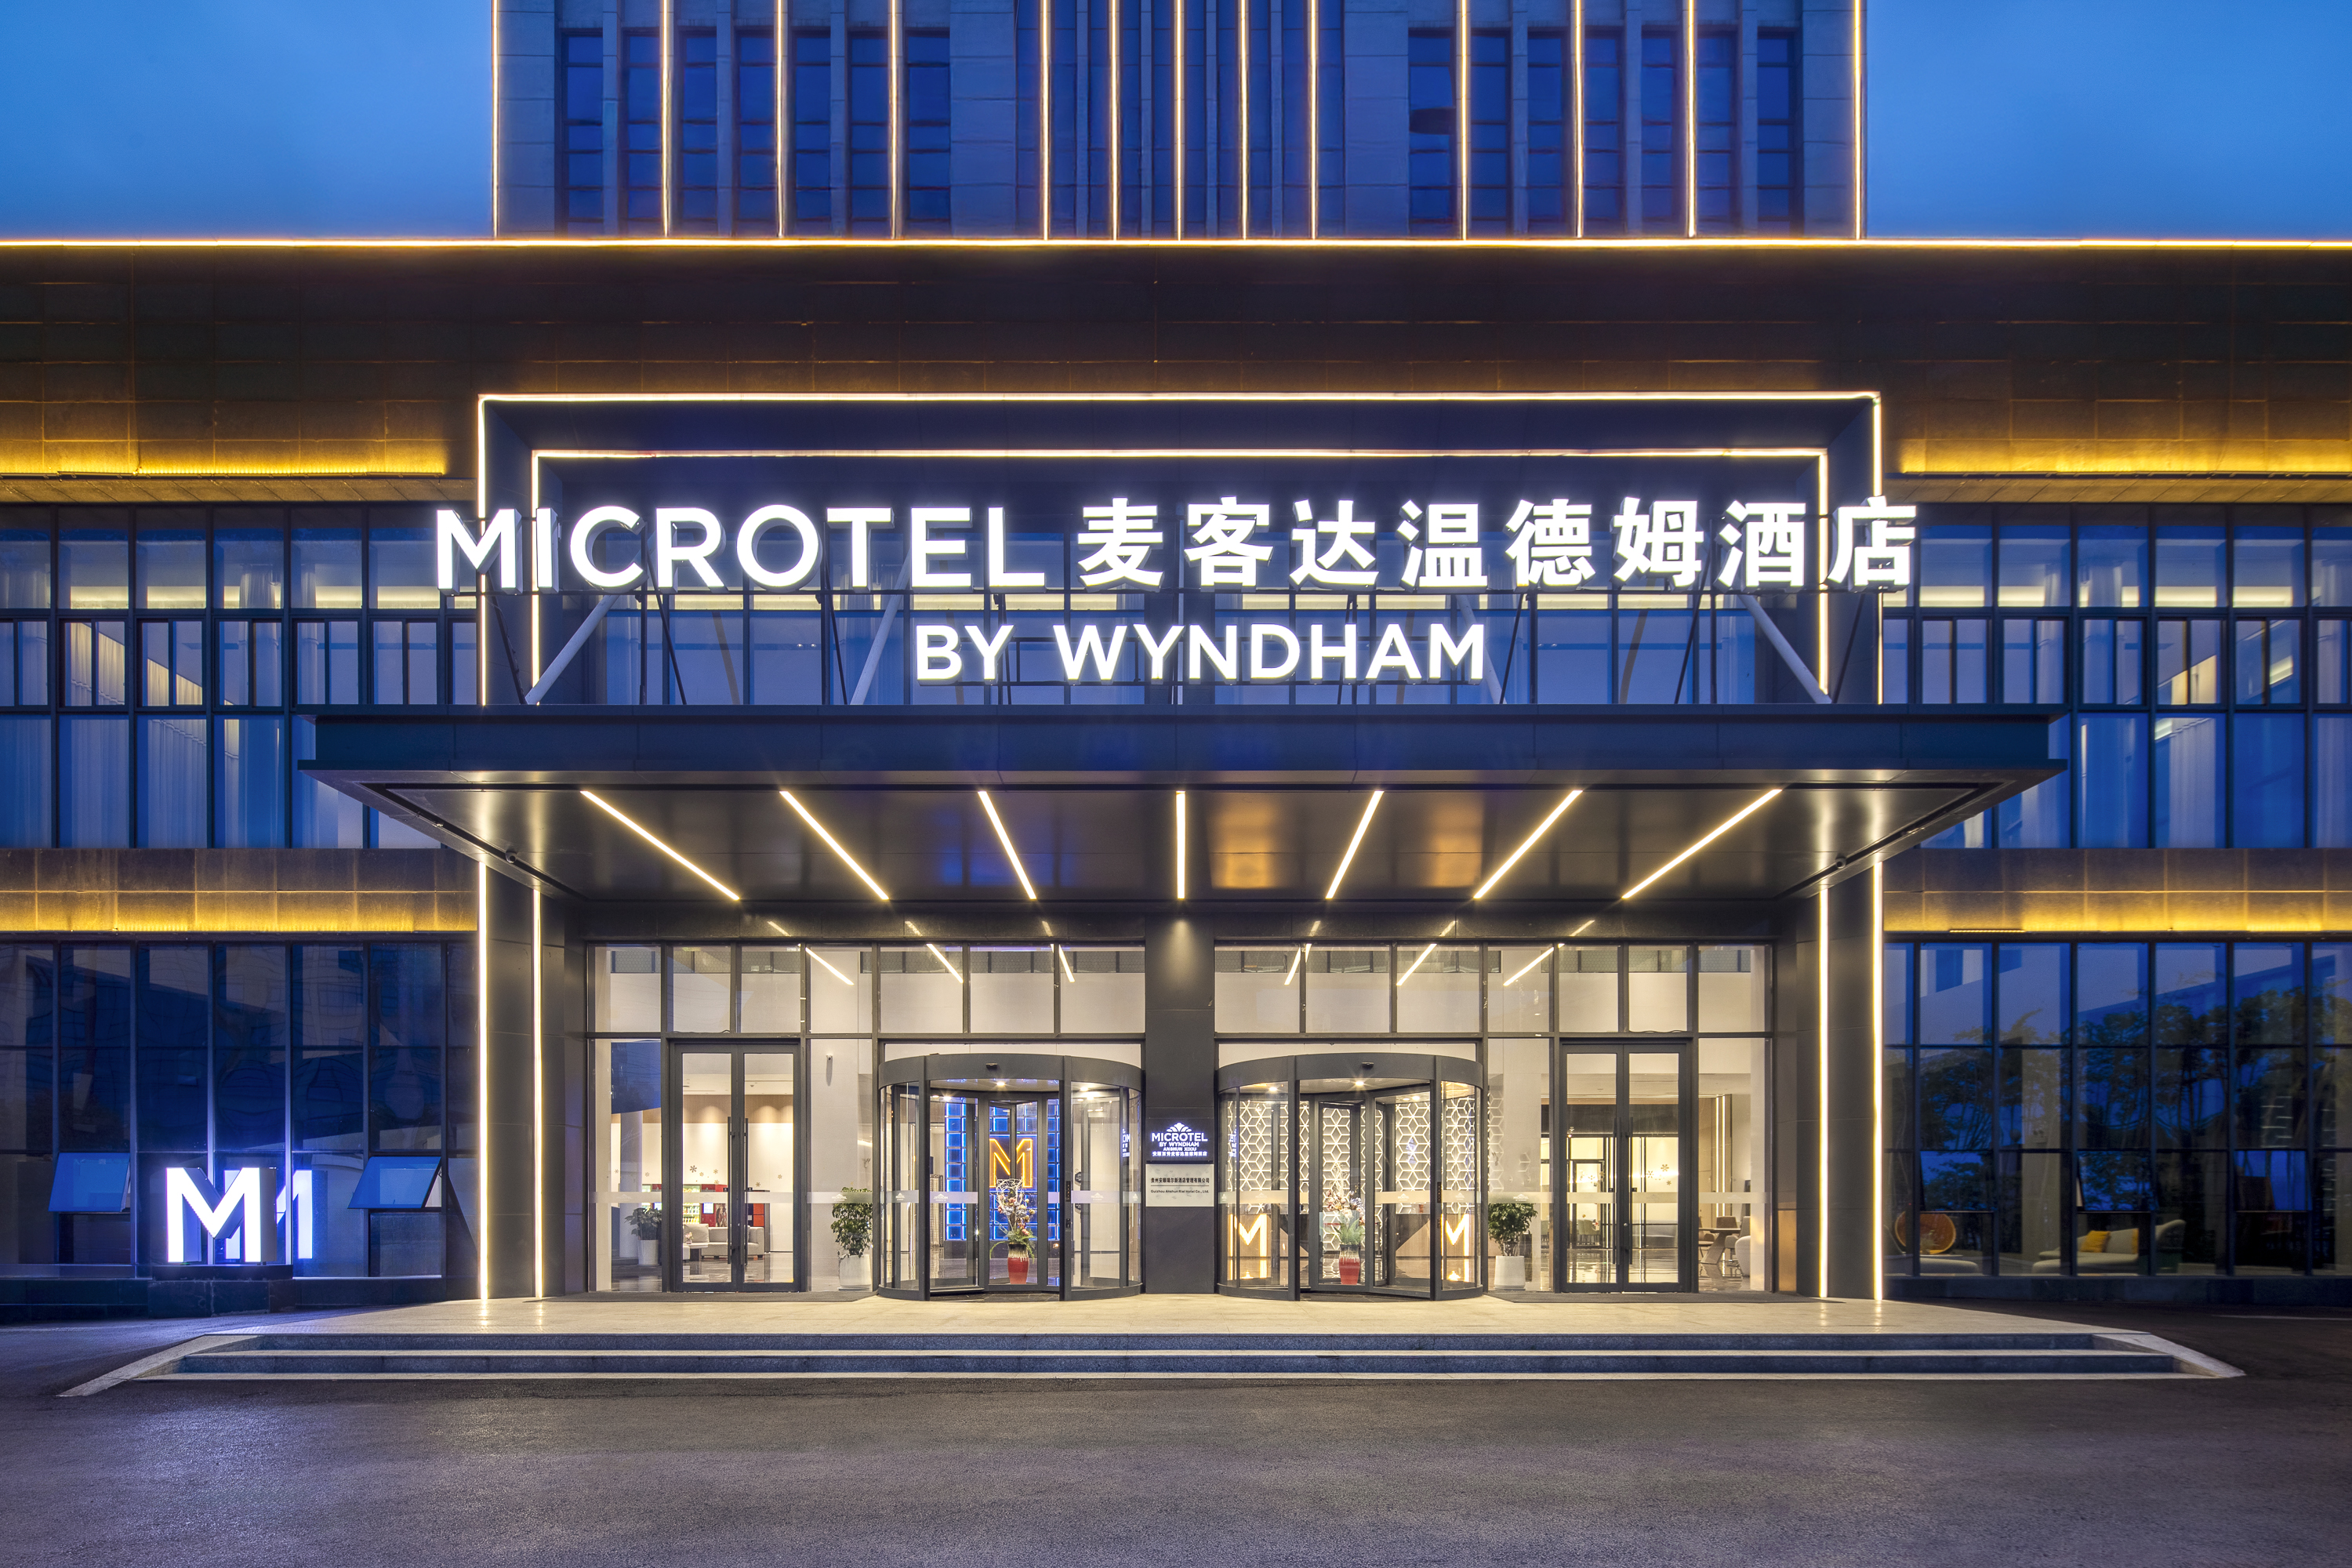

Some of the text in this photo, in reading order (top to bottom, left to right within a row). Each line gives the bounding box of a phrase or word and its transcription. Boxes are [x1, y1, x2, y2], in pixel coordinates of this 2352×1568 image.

[436, 504, 1046, 591] MICROTEL
[1077, 495, 1918, 592] 麦客达温德姆酒店
[916, 624, 1486, 683] BY WYNDHAM
[989, 1138, 1033, 1189] M
[1151, 1132, 1208, 1142] MICROTEL
[166, 1167, 270, 1262] M
[1229, 1214, 1268, 1257] M
